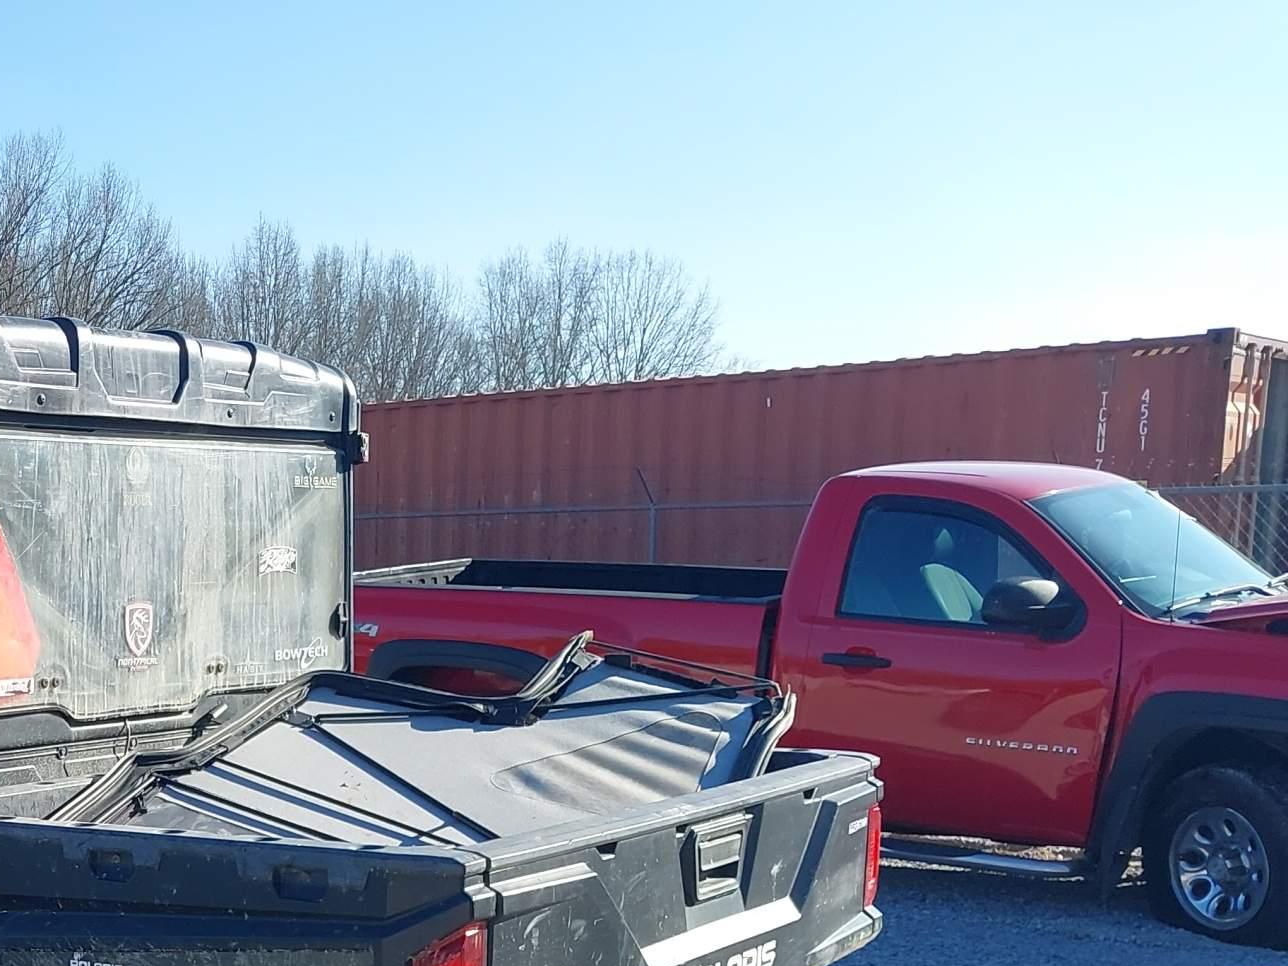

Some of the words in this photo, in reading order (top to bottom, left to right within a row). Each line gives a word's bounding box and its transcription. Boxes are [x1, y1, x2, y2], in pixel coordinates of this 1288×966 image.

[1096, 392, 1108, 453] TCNU
[1139, 389, 1150, 451] 45G1
[313, 476, 337, 487] GAME
[275, 641, 328, 665] BOWTECH
